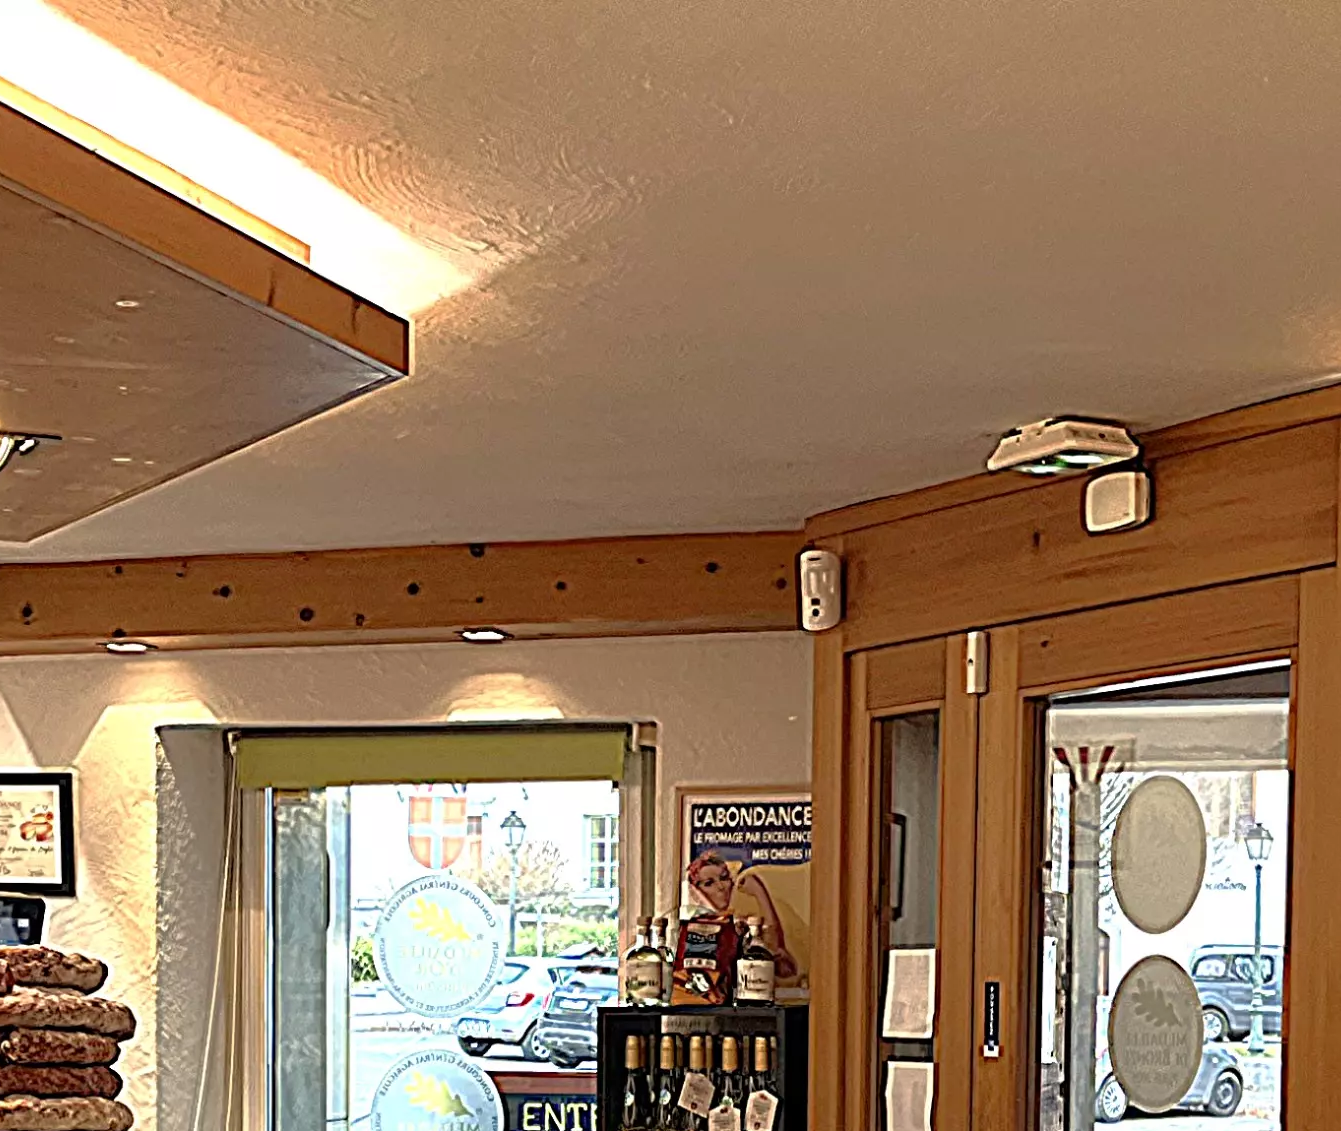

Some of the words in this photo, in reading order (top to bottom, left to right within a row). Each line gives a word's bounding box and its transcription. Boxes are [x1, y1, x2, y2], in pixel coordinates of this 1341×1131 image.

[693, 806, 812, 828] L'ABONDANCE
[694, 833, 703, 844] LE
[704, 832, 744, 844] FROMAGE
[745, 832, 761, 843] PAR
[762, 831, 812, 843] EXCELLENCE
[752, 849, 769, 860] MES
